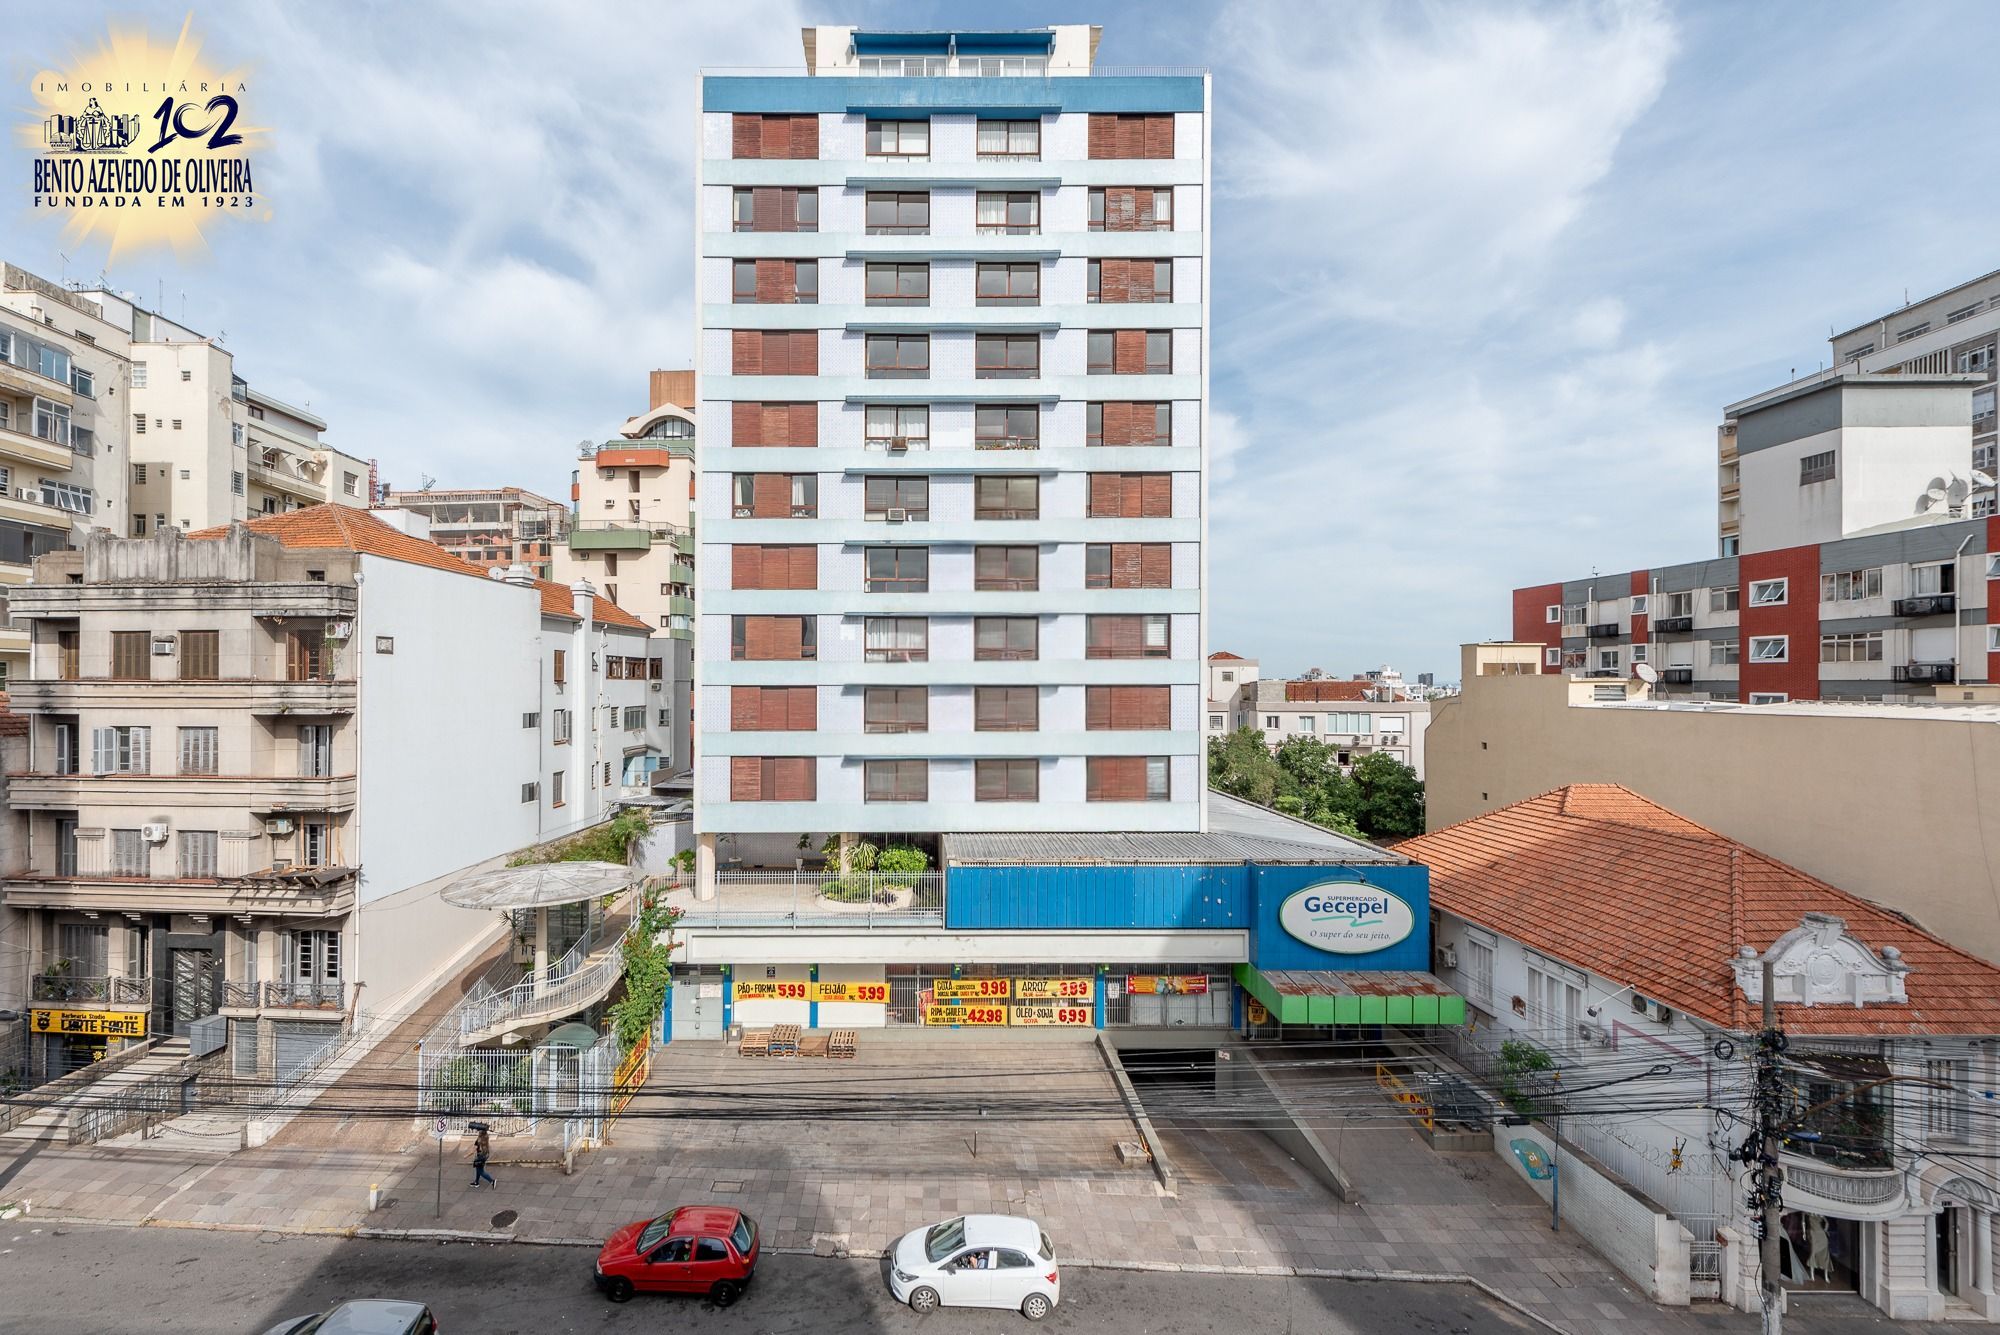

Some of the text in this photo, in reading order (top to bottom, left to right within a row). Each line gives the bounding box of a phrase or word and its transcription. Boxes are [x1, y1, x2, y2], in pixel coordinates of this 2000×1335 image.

[1304, 896, 1388, 918] Gecepel
[1319, 930, 1341, 939] super
[1343, 930, 1353, 939] do
[1371, 930, 1391, 941] jeito.
[755, 984, 776, 993] FORMA
[777, 984, 806, 999] 5.99
[819, 983, 847, 994] FEIJÃO
[858, 986, 885, 1000] 5.99
[980, 980, 1008, 996] 9.98
[1022, 981, 1049, 992] ARROZ
[967, 1008, 1003, 1023] 42.98
[1058, 1009, 1087, 1024] 6.99
[101, 1020, 139, 1034] FORTE
